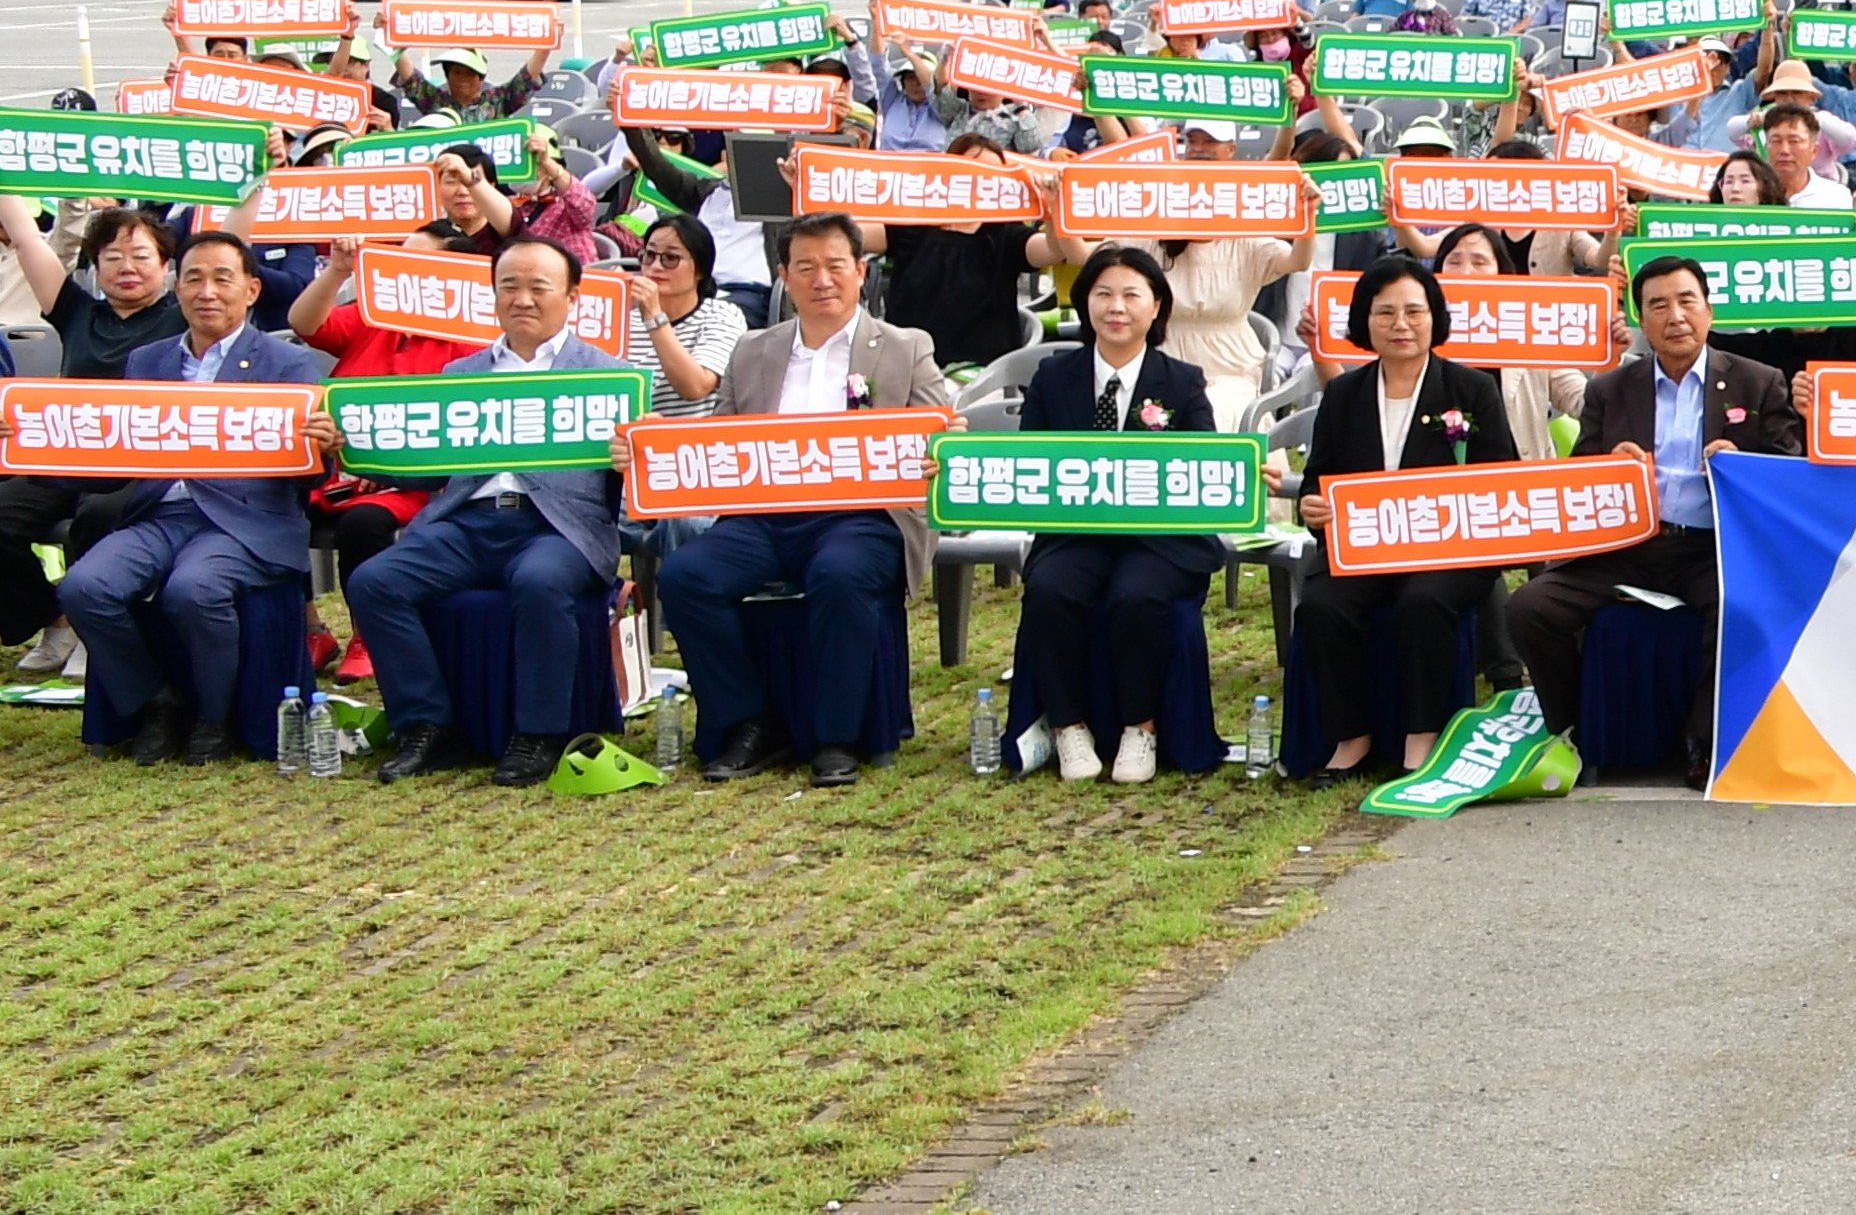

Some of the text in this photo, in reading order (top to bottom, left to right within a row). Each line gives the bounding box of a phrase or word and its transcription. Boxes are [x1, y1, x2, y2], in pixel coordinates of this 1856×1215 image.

[394, 9, 549, 38] 농어촌기본소득 보장!
[663, 15, 823, 57] 함평군 유치를 희망!
[1324, 48, 1505, 83] 함평군 유치를 희망!
[181, 69, 314, 117] 농어촌기본소득
[313, 93, 359, 123] 보장!
[625, 79, 822, 114] 농어촌기본소득 보장!
[1093, 70, 1279, 107] 함평군 유치를 희망!
[0, 129, 255, 184] 함평군 유치를 희망!
[367, 184, 424, 220] 보장!
[808, 166, 1030, 209] 농어촌기본소득 보장!
[1071, 181, 1296, 219] 농어촌기본소득 보장!
[1400, 177, 1606, 213] 농어촌기본소득 보장!
[1734, 259, 1824, 303] 유치를
[1531, 302, 1597, 345] 보장!
[13, 403, 295, 451] 농어촌기본소득 보장!
[341, 394, 629, 449] 함평군 유치를 희망!
[645, 437, 862, 490] 농어촌기본소득
[948, 456, 1244, 506] 함평군 유치를 희망!
[1347, 483, 1637, 547] 농어촌기본소득 보장!
